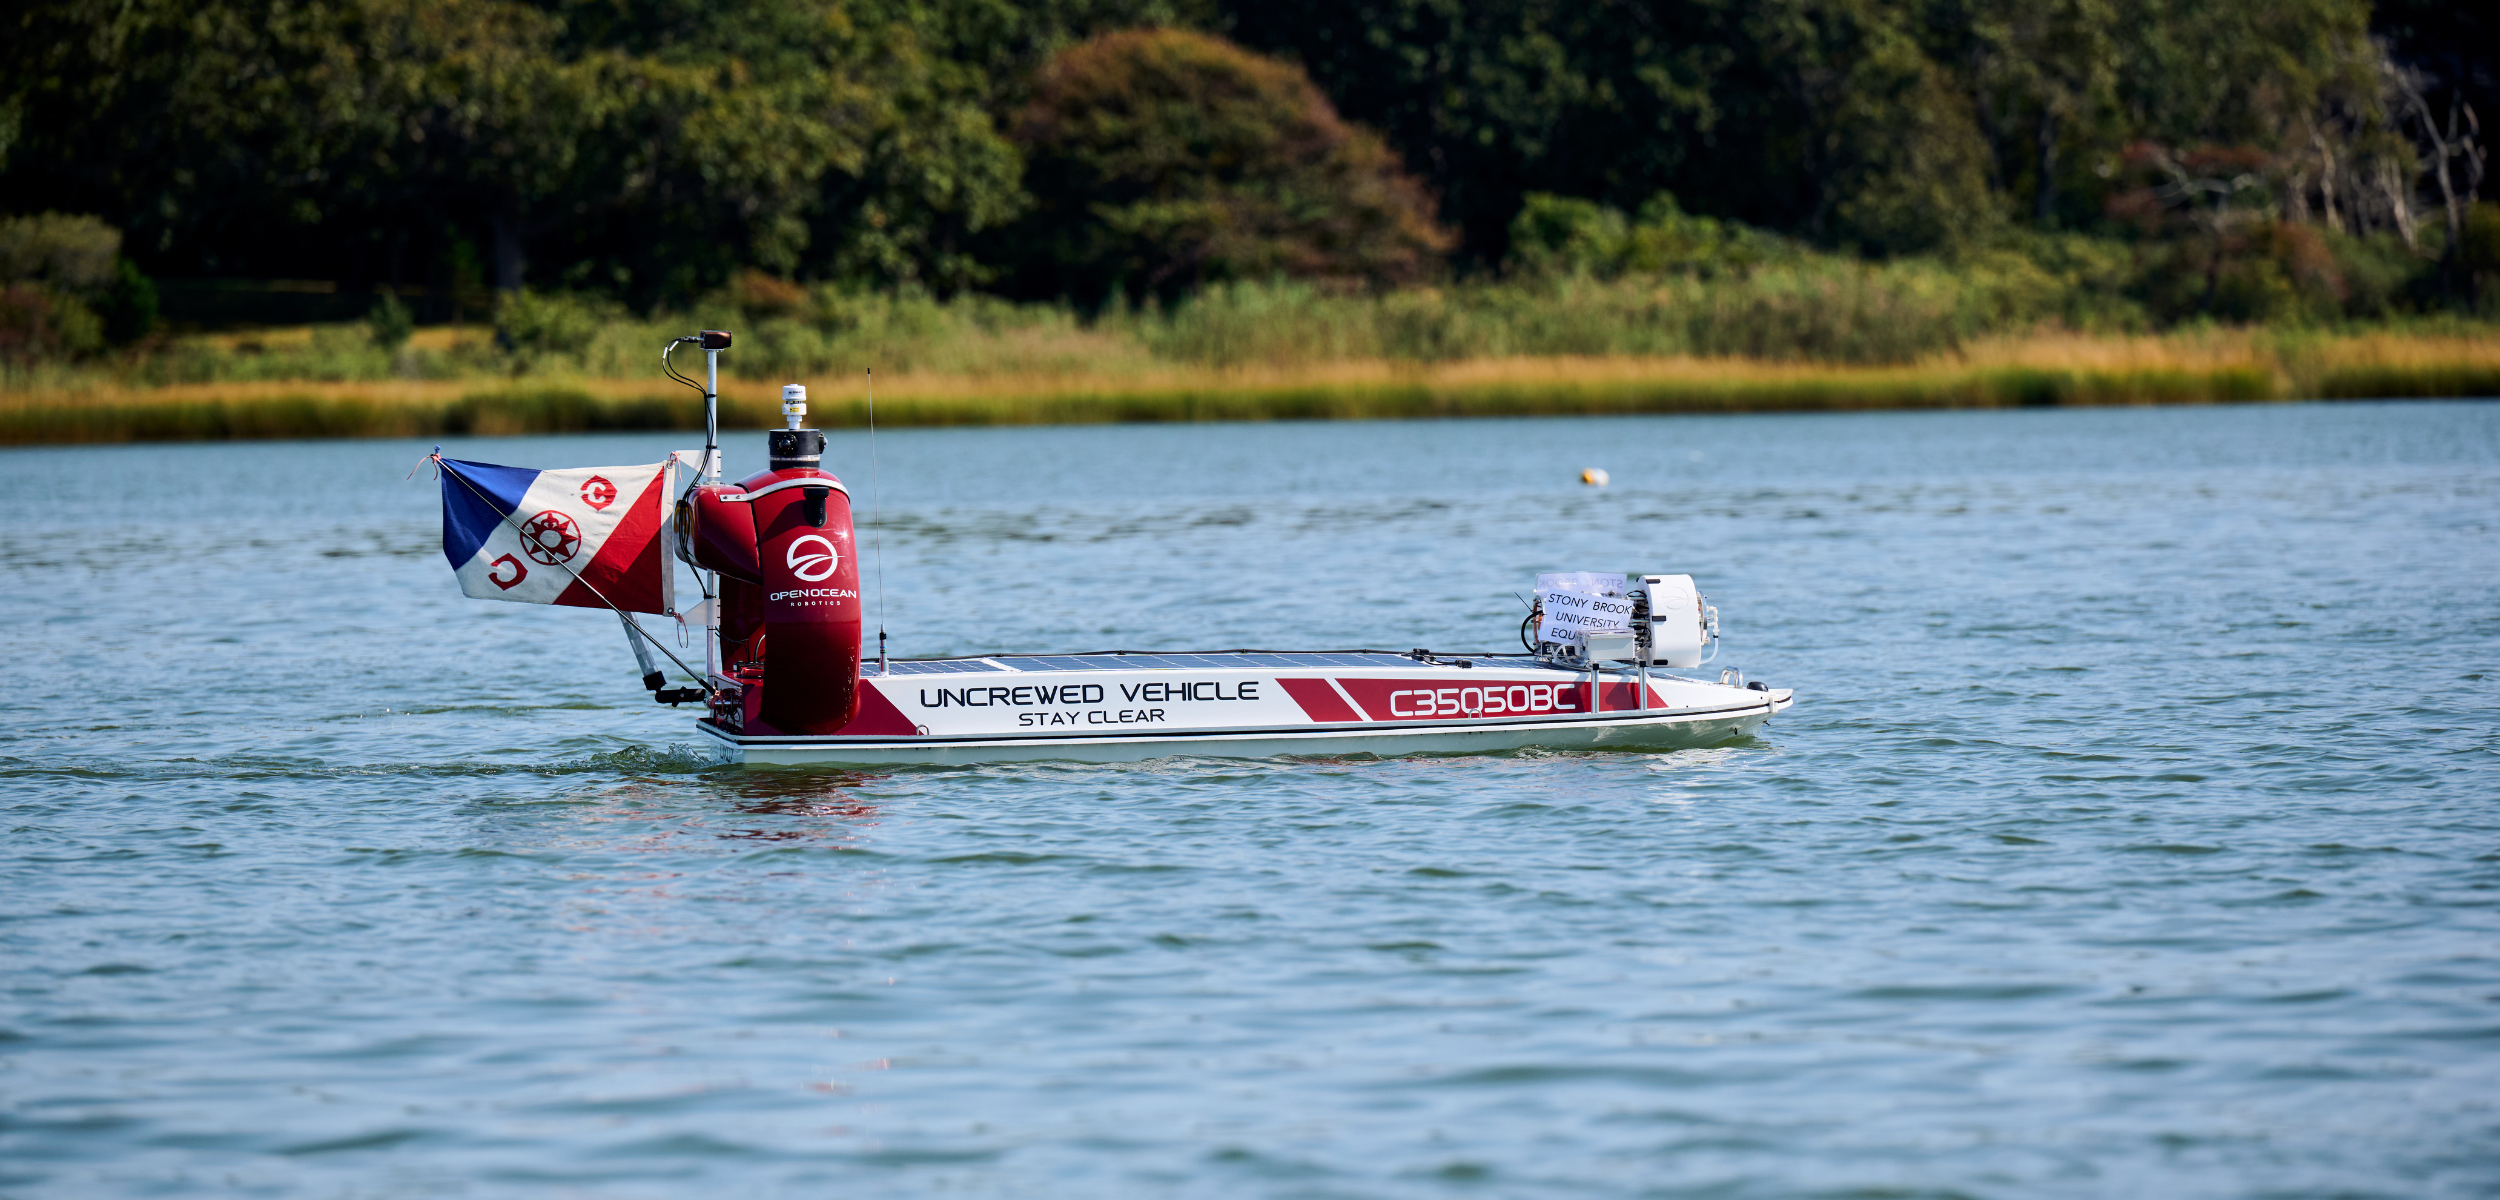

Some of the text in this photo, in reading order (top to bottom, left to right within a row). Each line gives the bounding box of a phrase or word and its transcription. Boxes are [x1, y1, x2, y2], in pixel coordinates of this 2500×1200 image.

[1548, 593, 1632, 615] STONY BROOK
[1555, 611, 1620, 628] UNIVERSITY
[1550, 627, 1576, 640] EQU
[920, 681, 1260, 707] UNCREWED VEHICLE
[1390, 684, 1577, 717] C35050BC
[1018, 708, 1166, 727] STAY CLEAR
